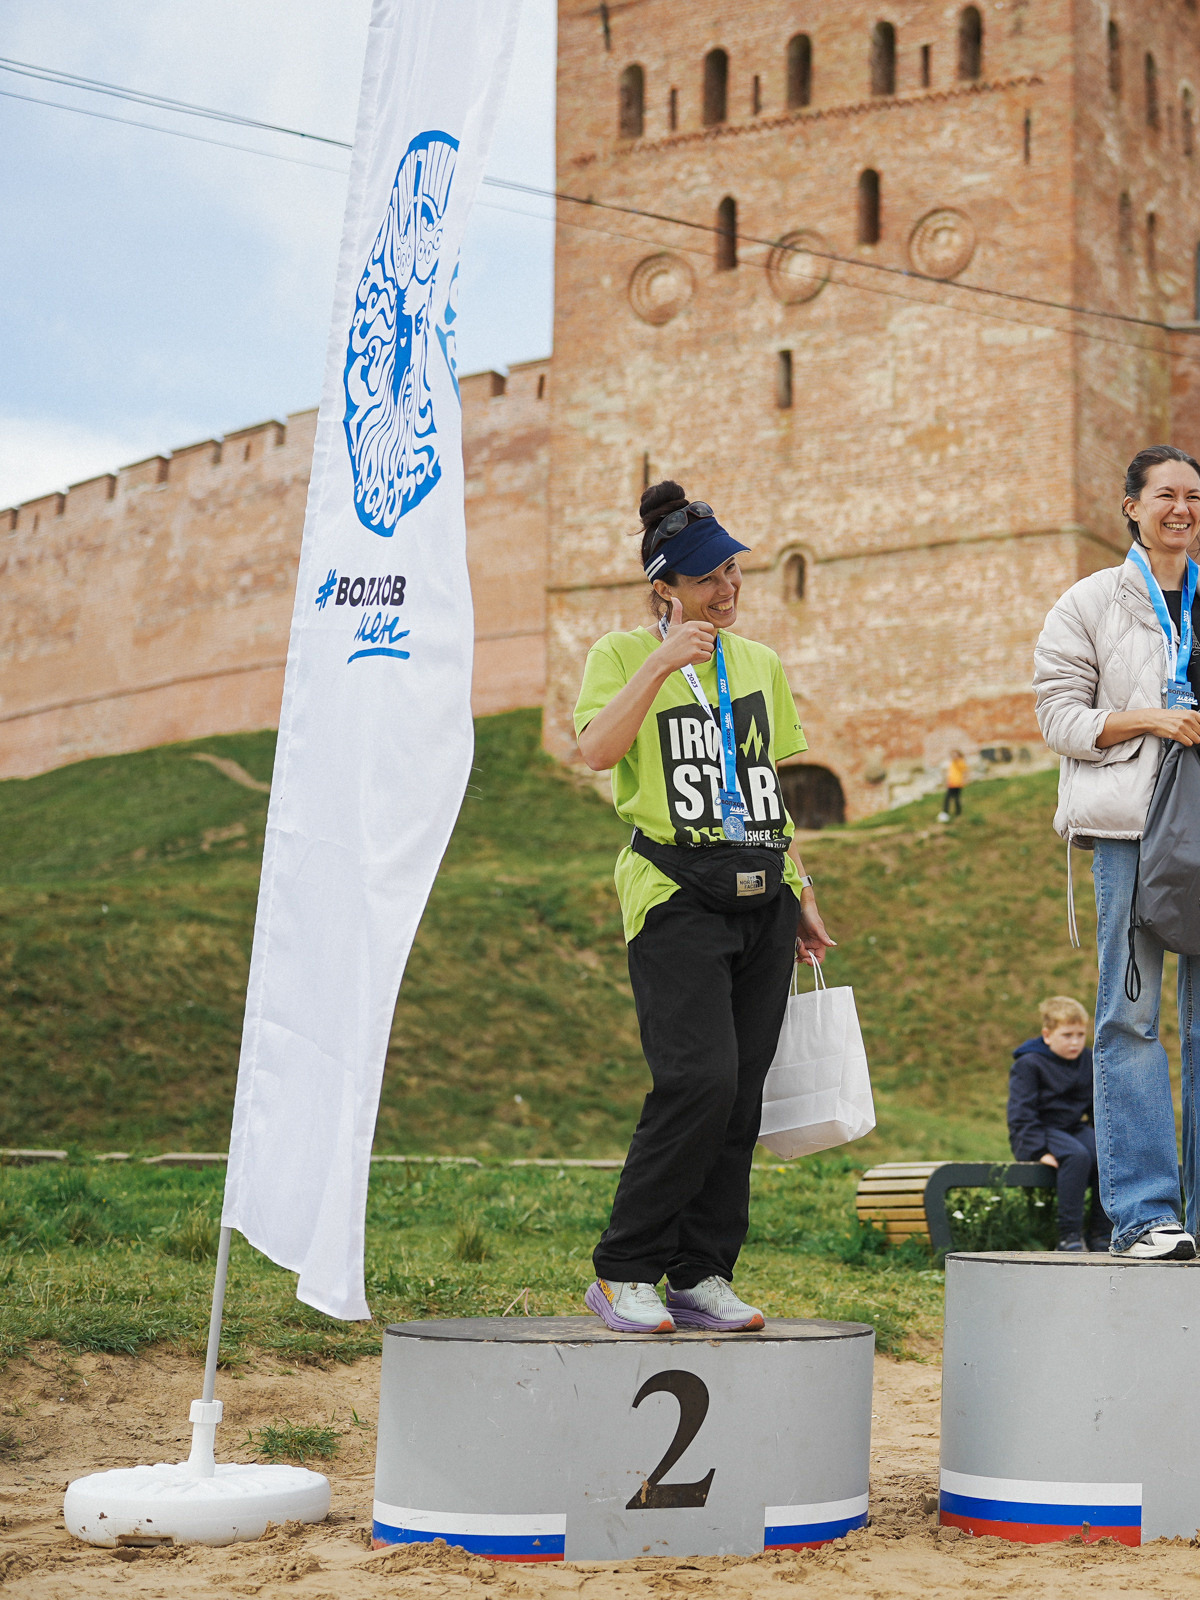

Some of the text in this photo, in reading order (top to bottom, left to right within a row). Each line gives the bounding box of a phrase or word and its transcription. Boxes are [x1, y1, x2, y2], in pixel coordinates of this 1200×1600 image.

[315, 569, 406, 611] #ВОЛХОВ
[668, 717, 721, 762] IRO
[744, 829, 772, 842] ISHER
[626, 1369, 716, 1509] 2
